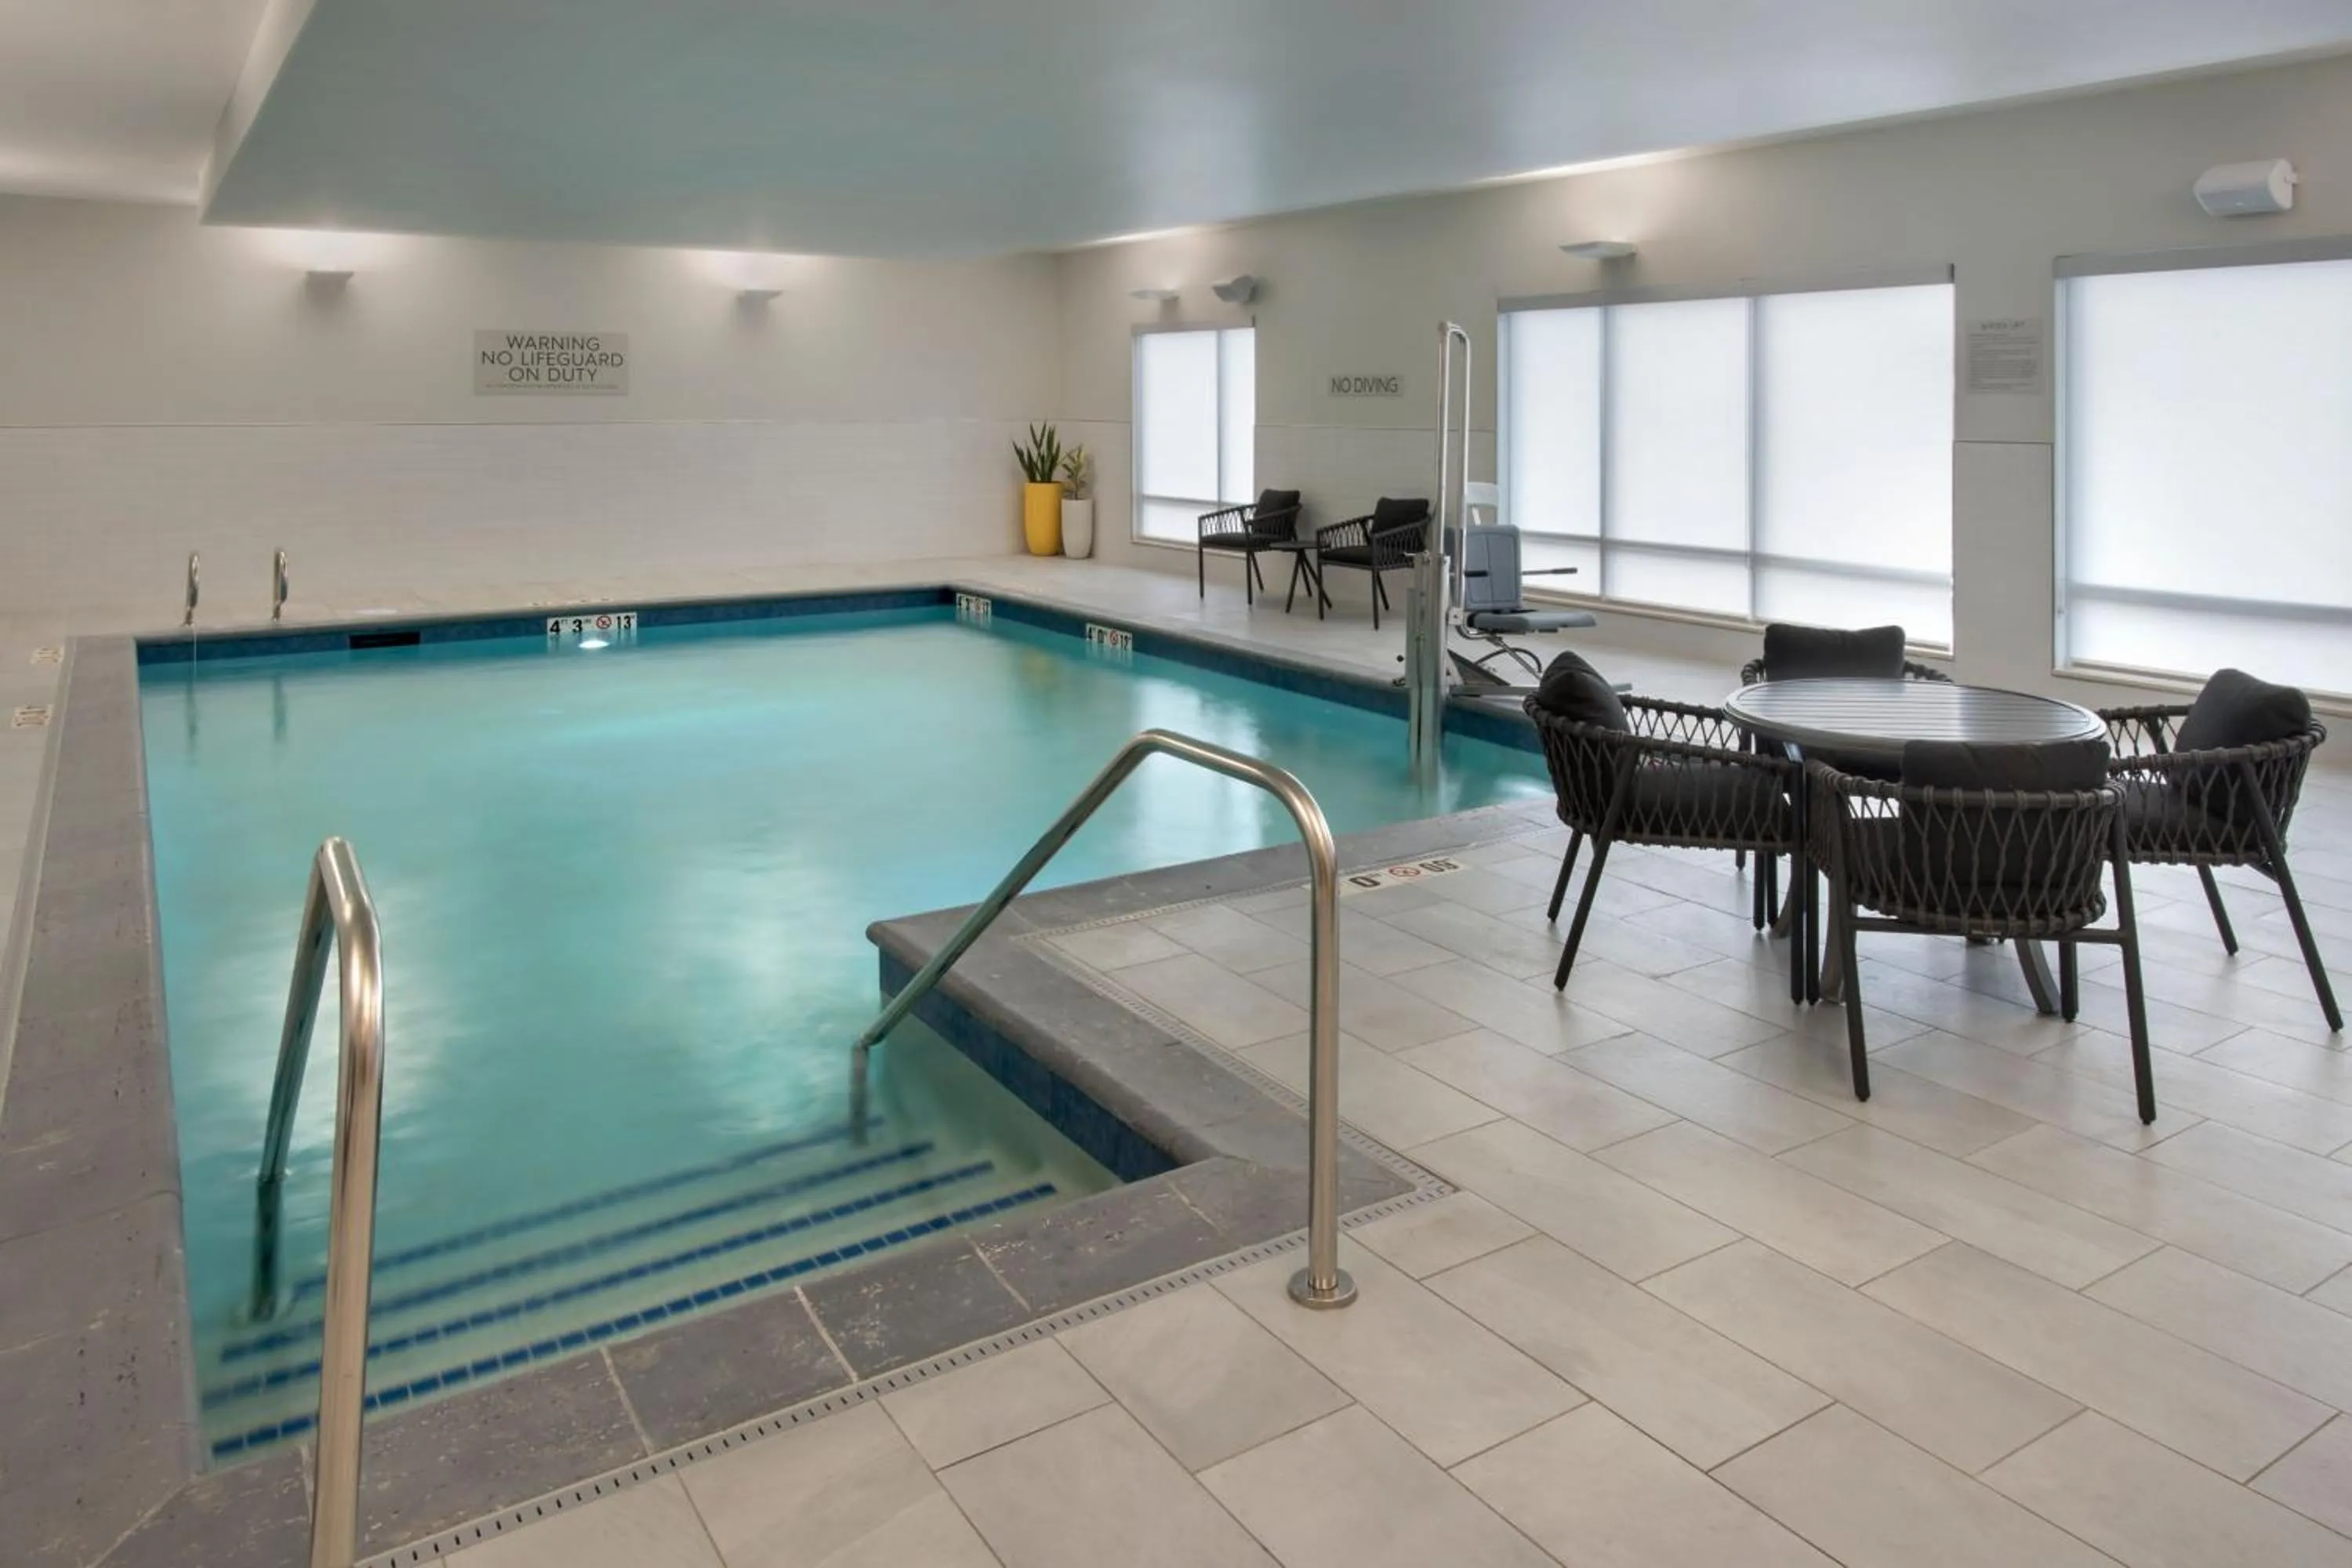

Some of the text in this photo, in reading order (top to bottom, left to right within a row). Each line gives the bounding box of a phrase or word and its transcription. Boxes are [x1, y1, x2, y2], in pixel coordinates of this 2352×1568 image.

[506, 335, 601, 351] WARNING
[482, 351, 624, 367] NO LIFEGUARD
[509, 367, 598, 382] ON DUTY
[1332, 376, 1398, 393] NO DIVING
[550, 619, 561, 633] 4
[572, 619, 583, 633] 3
